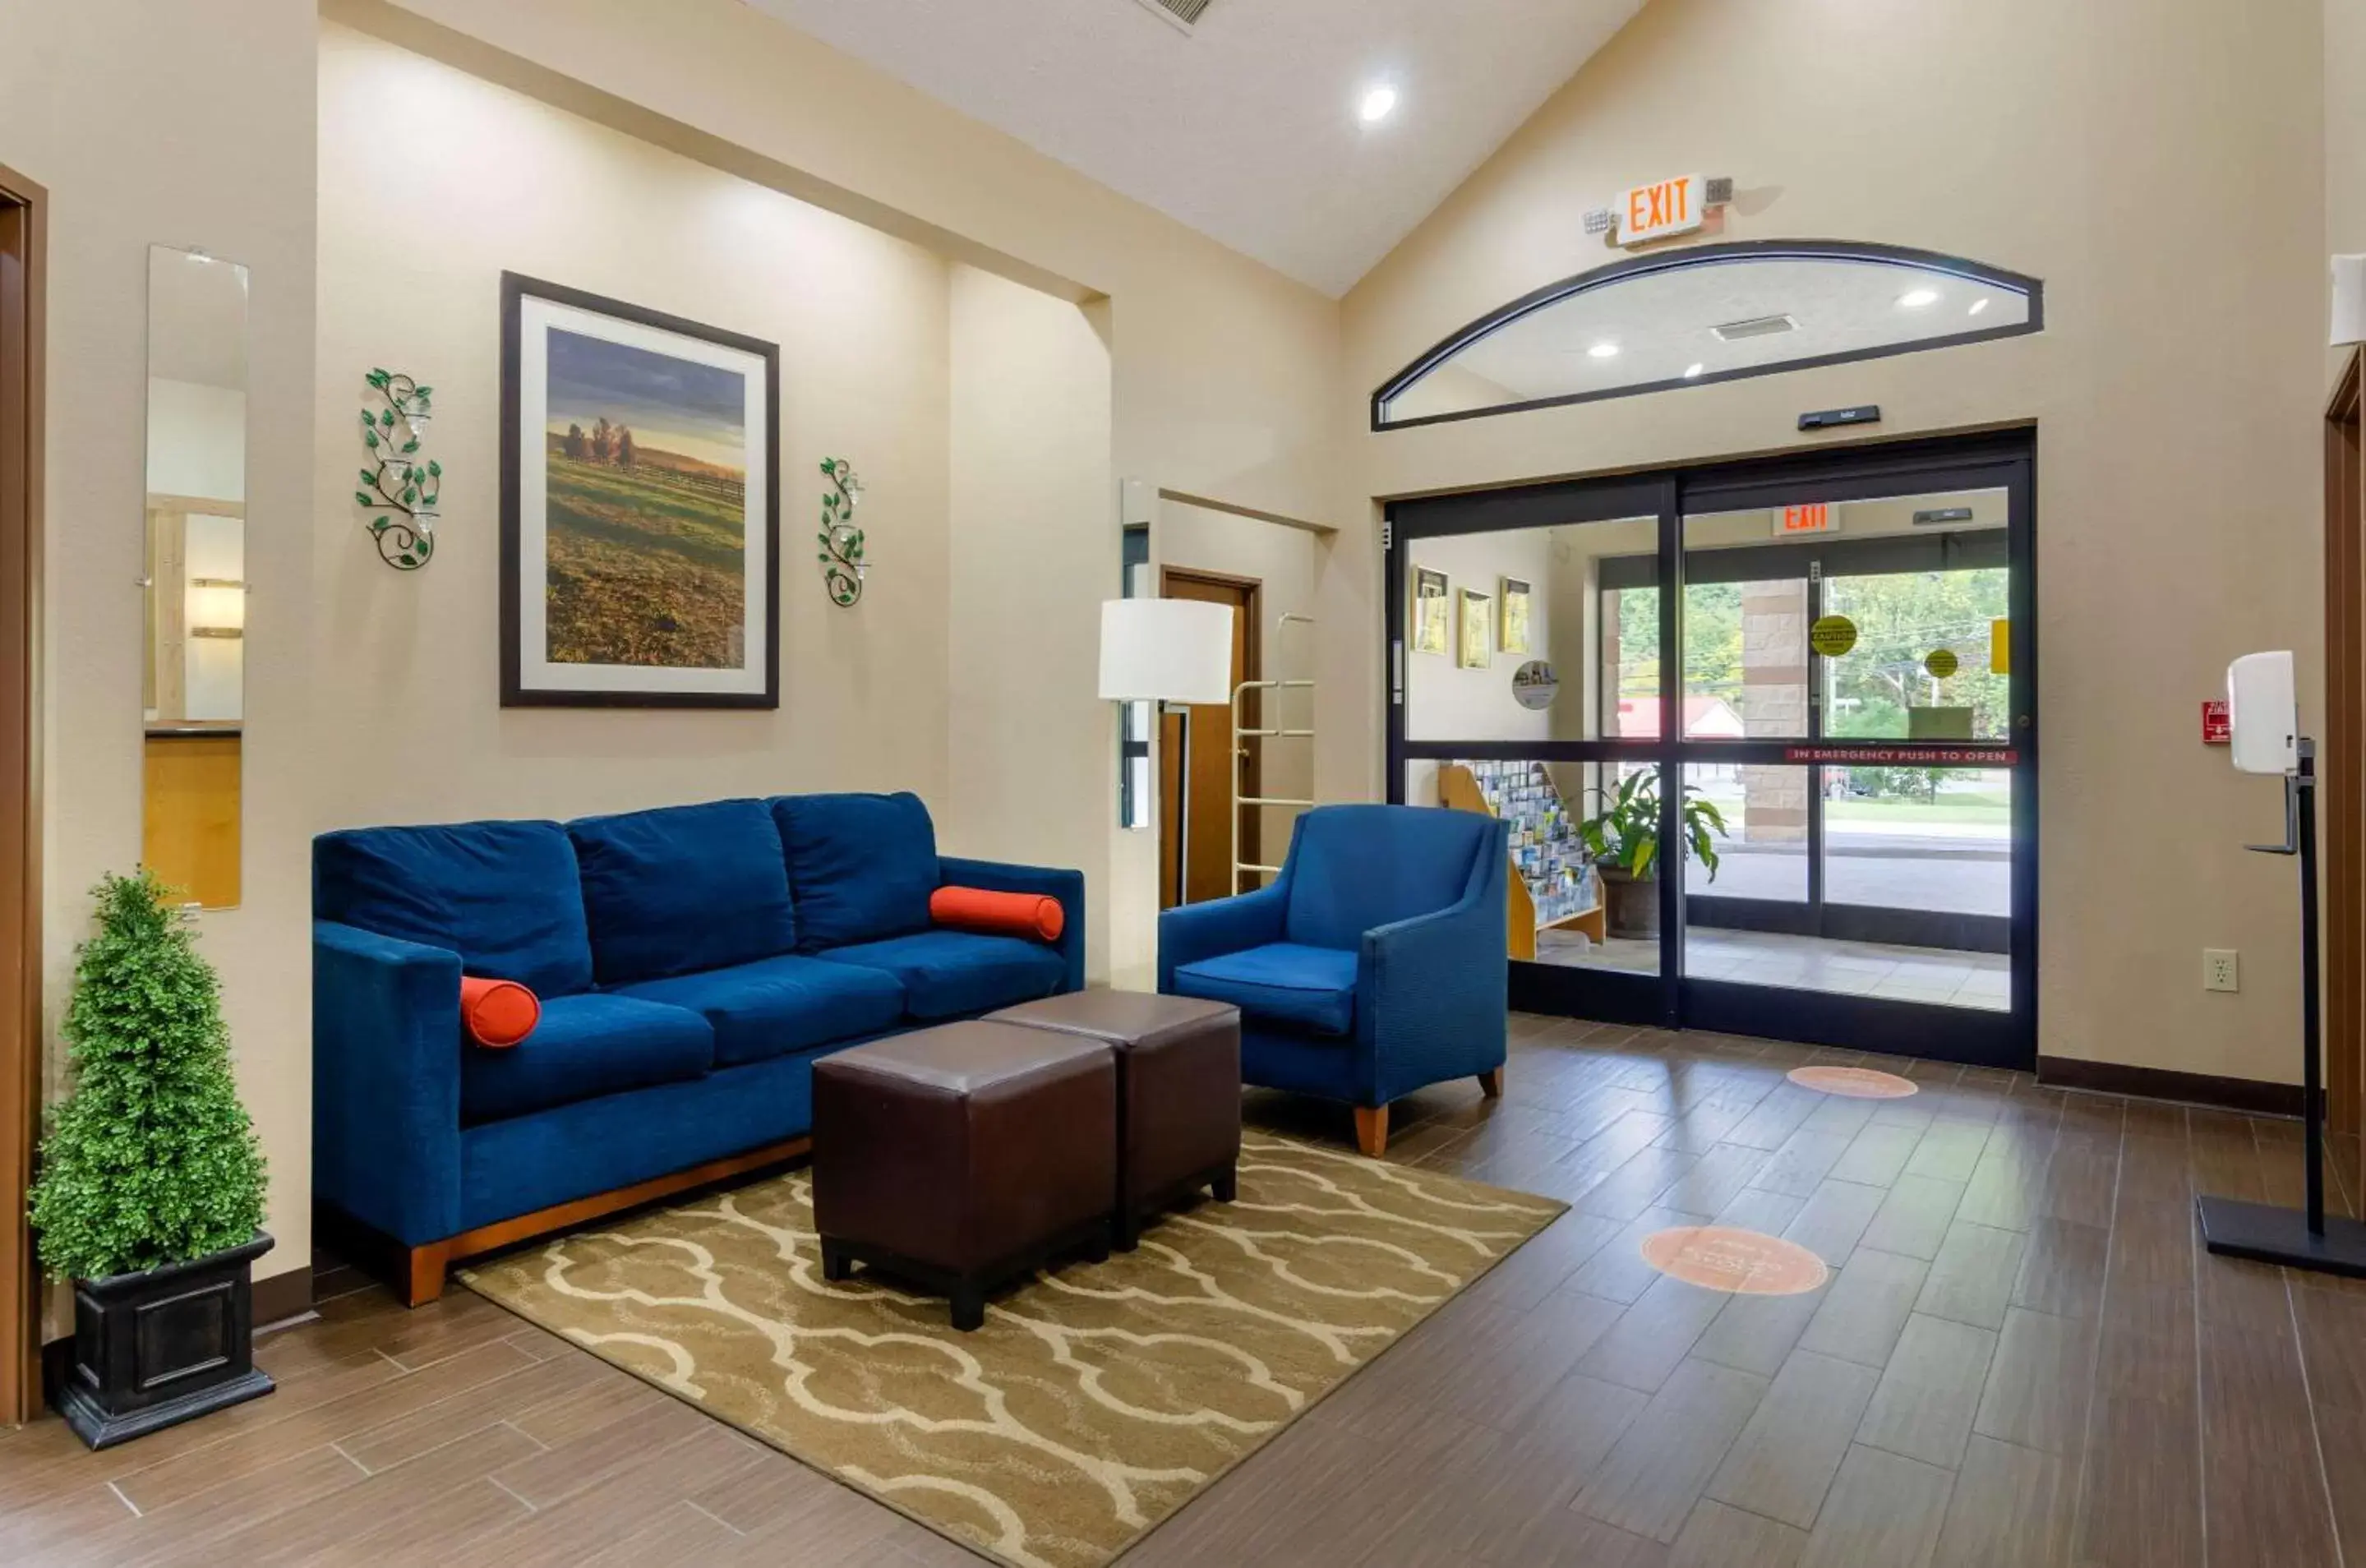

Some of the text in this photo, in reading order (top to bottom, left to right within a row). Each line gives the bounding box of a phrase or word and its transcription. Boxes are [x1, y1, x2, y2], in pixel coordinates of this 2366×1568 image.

[1630, 178, 1689, 232] EXIT
[1785, 505, 1827, 532] EXIT
[1794, 749, 2007, 761] IN EMERGENCY PUSH TO OPEN
